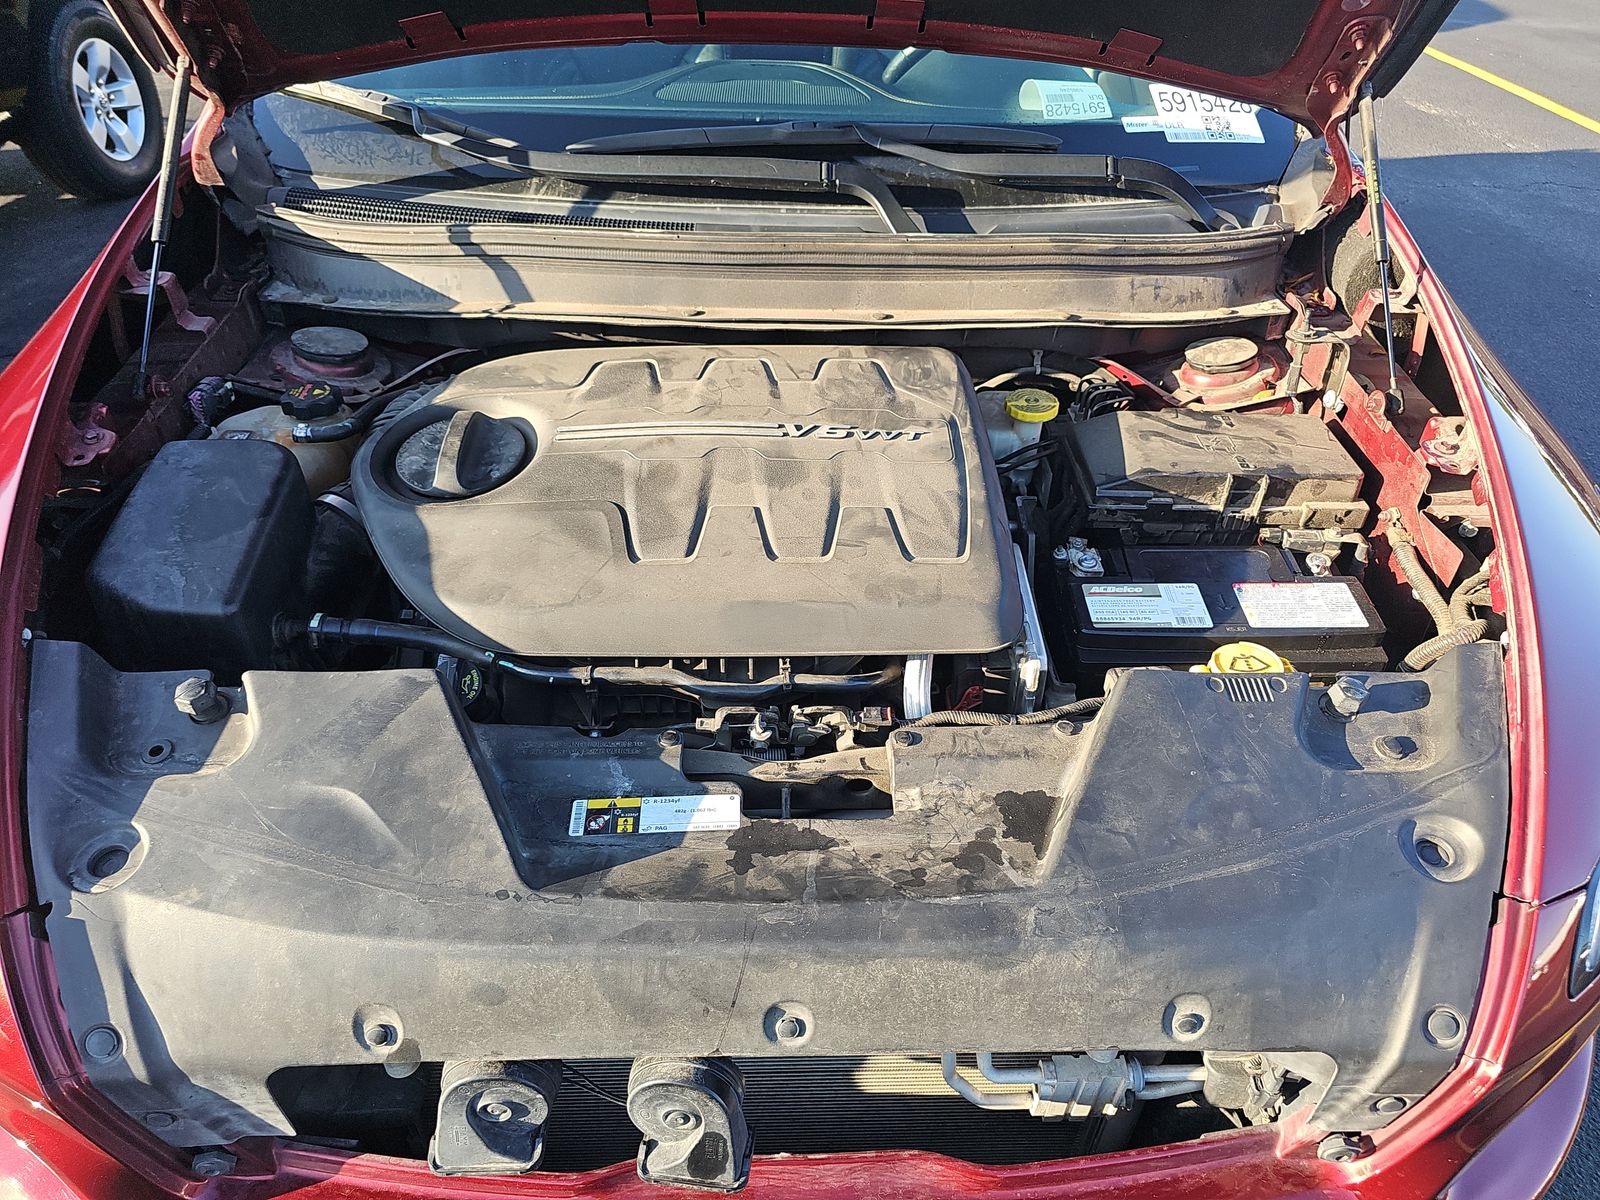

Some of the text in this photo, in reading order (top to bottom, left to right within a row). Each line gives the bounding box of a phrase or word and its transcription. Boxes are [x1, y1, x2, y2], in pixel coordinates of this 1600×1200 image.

[1045, 101, 1106, 118] 5915428
[1089, 585, 1143, 593] ACDelco
[466, 669, 479, 700] ENGINE OIL
